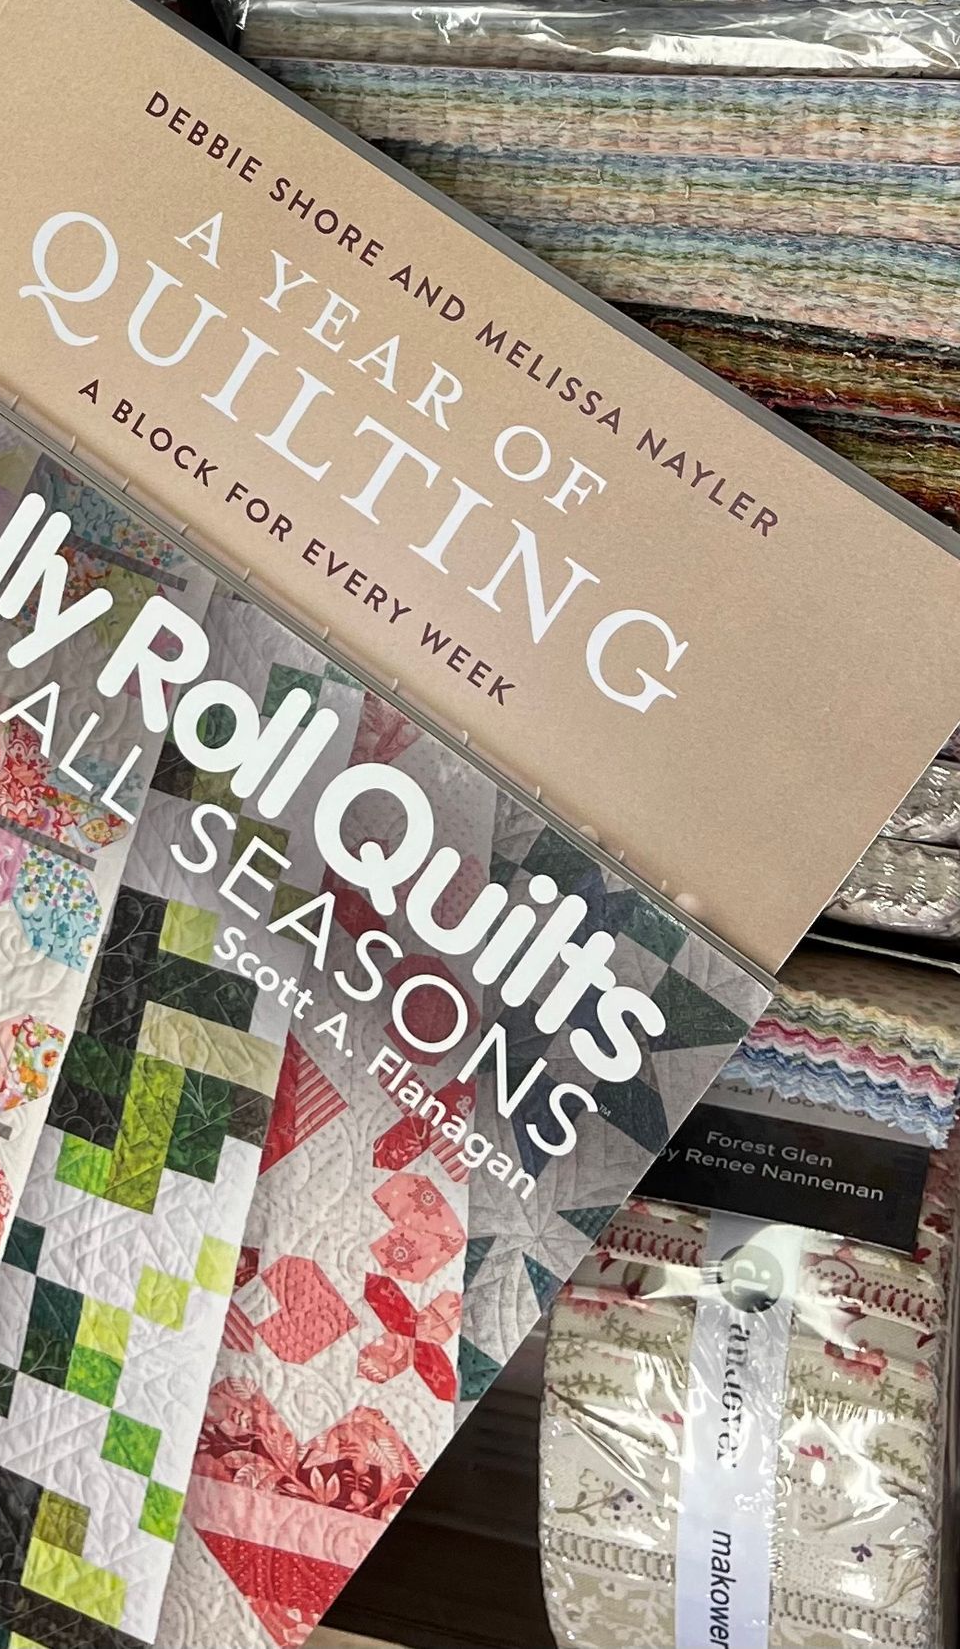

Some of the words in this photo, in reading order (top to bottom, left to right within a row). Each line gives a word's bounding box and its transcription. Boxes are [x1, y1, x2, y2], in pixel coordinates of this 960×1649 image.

[18, 210, 690, 714] QUILTING
[144, 90, 264, 184] DEBBIE
[269, 176, 385, 268] SHORE
[388, 263, 466, 323] AND
[475, 320, 622, 435] MELISSA
[636, 427, 780, 538] NAYLER
[174, 210, 224, 270] A
[259, 248, 464, 432] YEAR
[493, 423, 608, 515] OF
[78, 378, 100, 405] A
[111, 398, 219, 487] BLOCK
[224, 481, 294, 543] FOR
[300, 537, 413, 625] EVERY
[419, 621, 517, 707] WEEK
[95, 594, 340, 820] Roll
[313, 761, 668, 1083] Quilts
[168, 802, 599, 1157] SEASONS
[212, 925, 315, 1022] Scott
[314, 1012, 355, 1058] A.
[365, 1045, 538, 1200] Flanagan
[684, 1147, 756, 1175] Renee
[761, 1163, 885, 1202] Nanneman
[706, 1130, 776, 1157] Forest
[781, 1147, 834, 1169] Glen
[708, 1530, 739, 1649] makower
